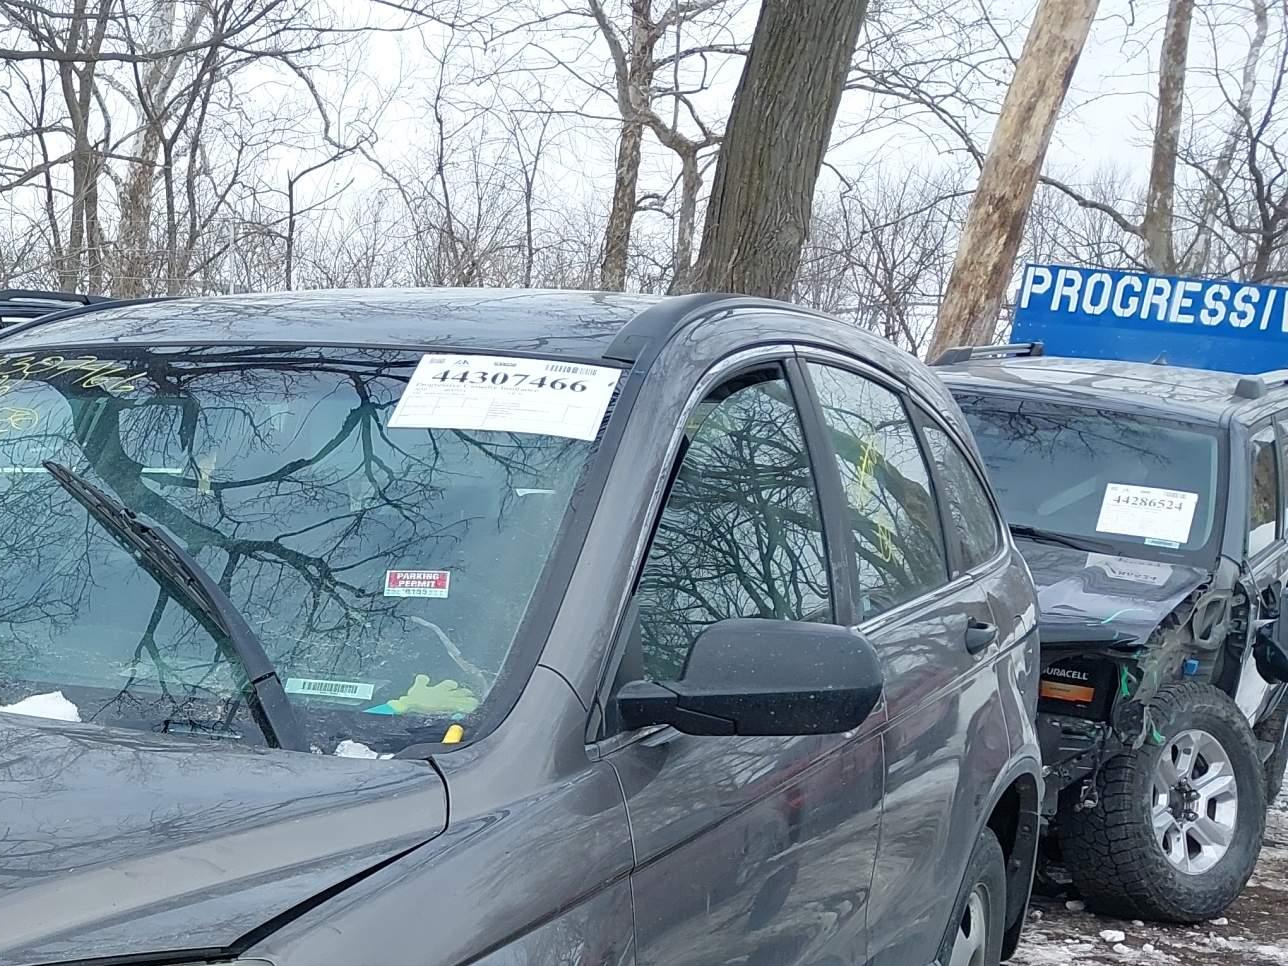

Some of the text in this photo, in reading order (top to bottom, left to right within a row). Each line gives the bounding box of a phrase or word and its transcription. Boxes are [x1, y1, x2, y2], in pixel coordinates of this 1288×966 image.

[1020, 265, 1288, 333] PROGRESSI
[431, 368, 587, 393] 44307466
[1112, 494, 1184, 512] 44286524
[396, 572, 440, 581] PARKING
[397, 580, 437, 588] PERMIT
